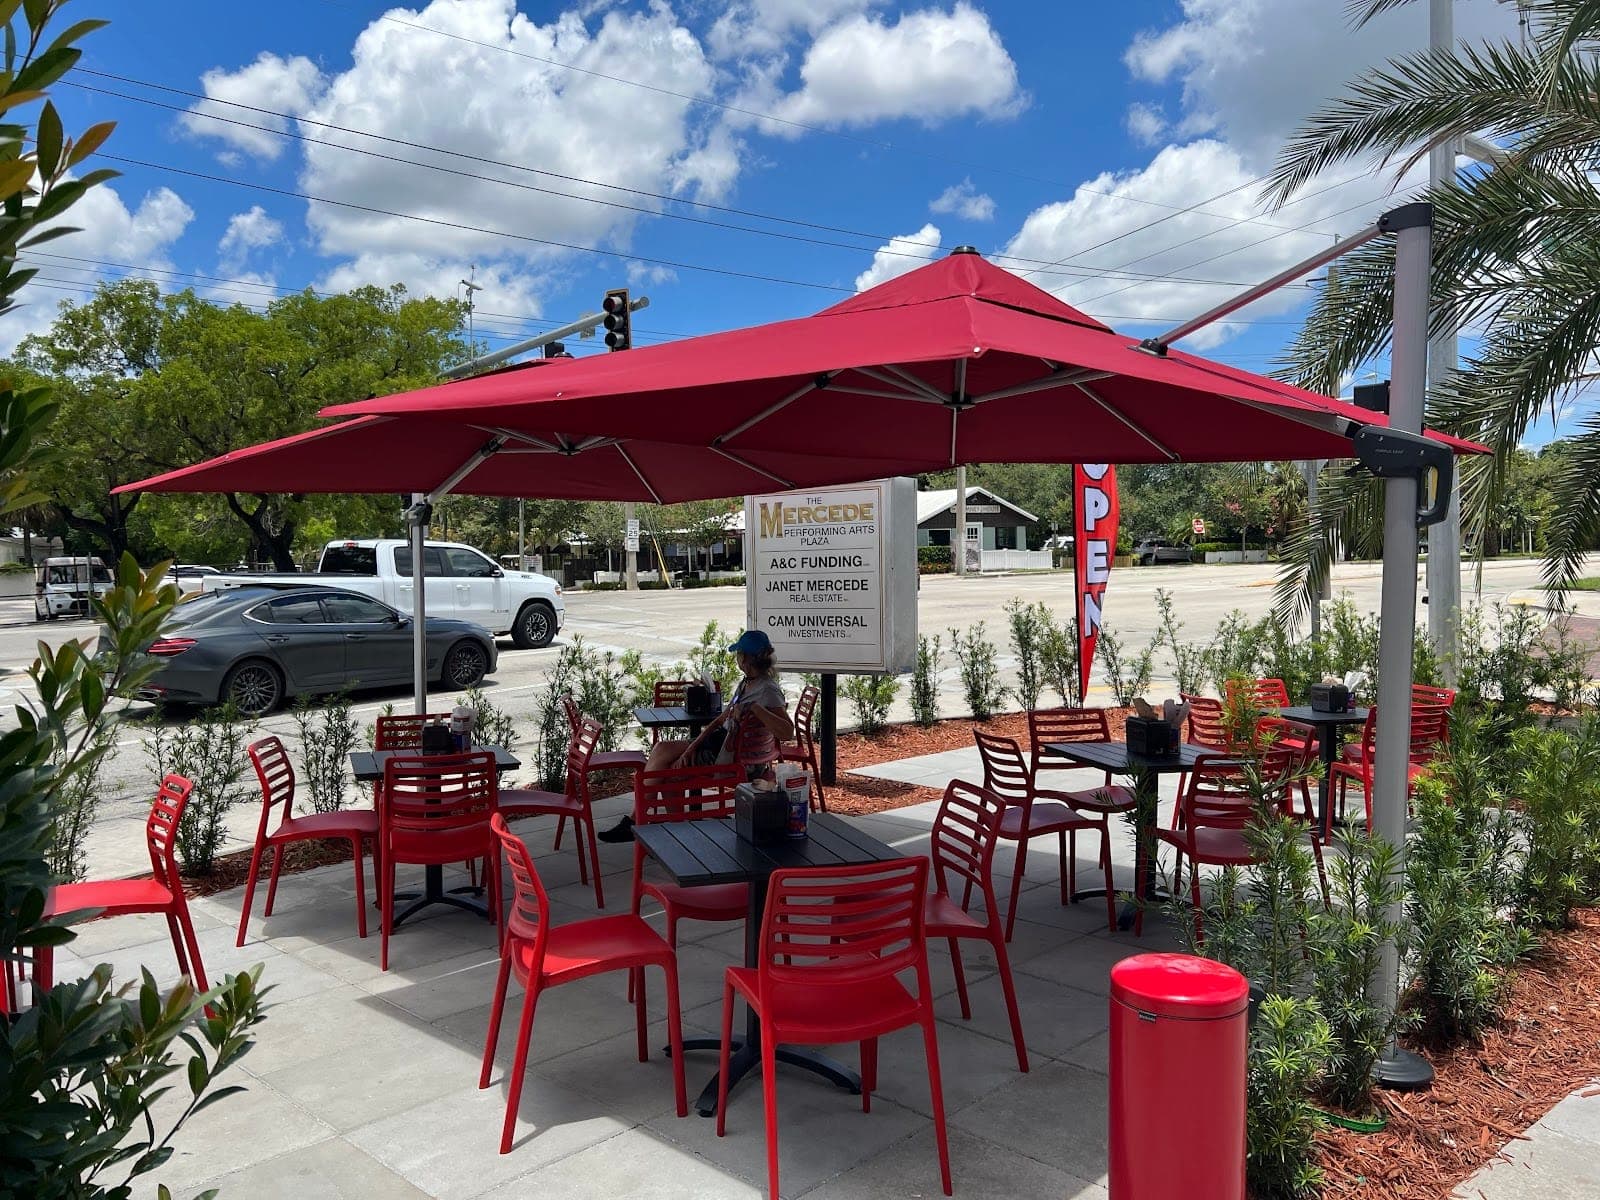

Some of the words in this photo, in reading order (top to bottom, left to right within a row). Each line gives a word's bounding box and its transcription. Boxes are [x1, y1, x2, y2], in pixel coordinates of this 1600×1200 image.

[806, 496, 823, 505] THE
[759, 501, 874, 538] MERCEDE
[784, 526, 847, 537] PERFORMING
[848, 525, 875, 534] ARTS
[800, 537, 830, 546] PLAZA
[770, 557, 797, 569] A&C
[801, 555, 863, 569] FUNDING
[765, 580, 803, 592] JANET
[807, 579, 869, 592] MERCEDE
[789, 594, 811, 603] REAL
[813, 594, 843, 602] ESTATE
[768, 616, 795, 627] CAM
[798, 615, 868, 627] UNIVERSAL
[788, 629, 846, 638] INVESTMENTS
